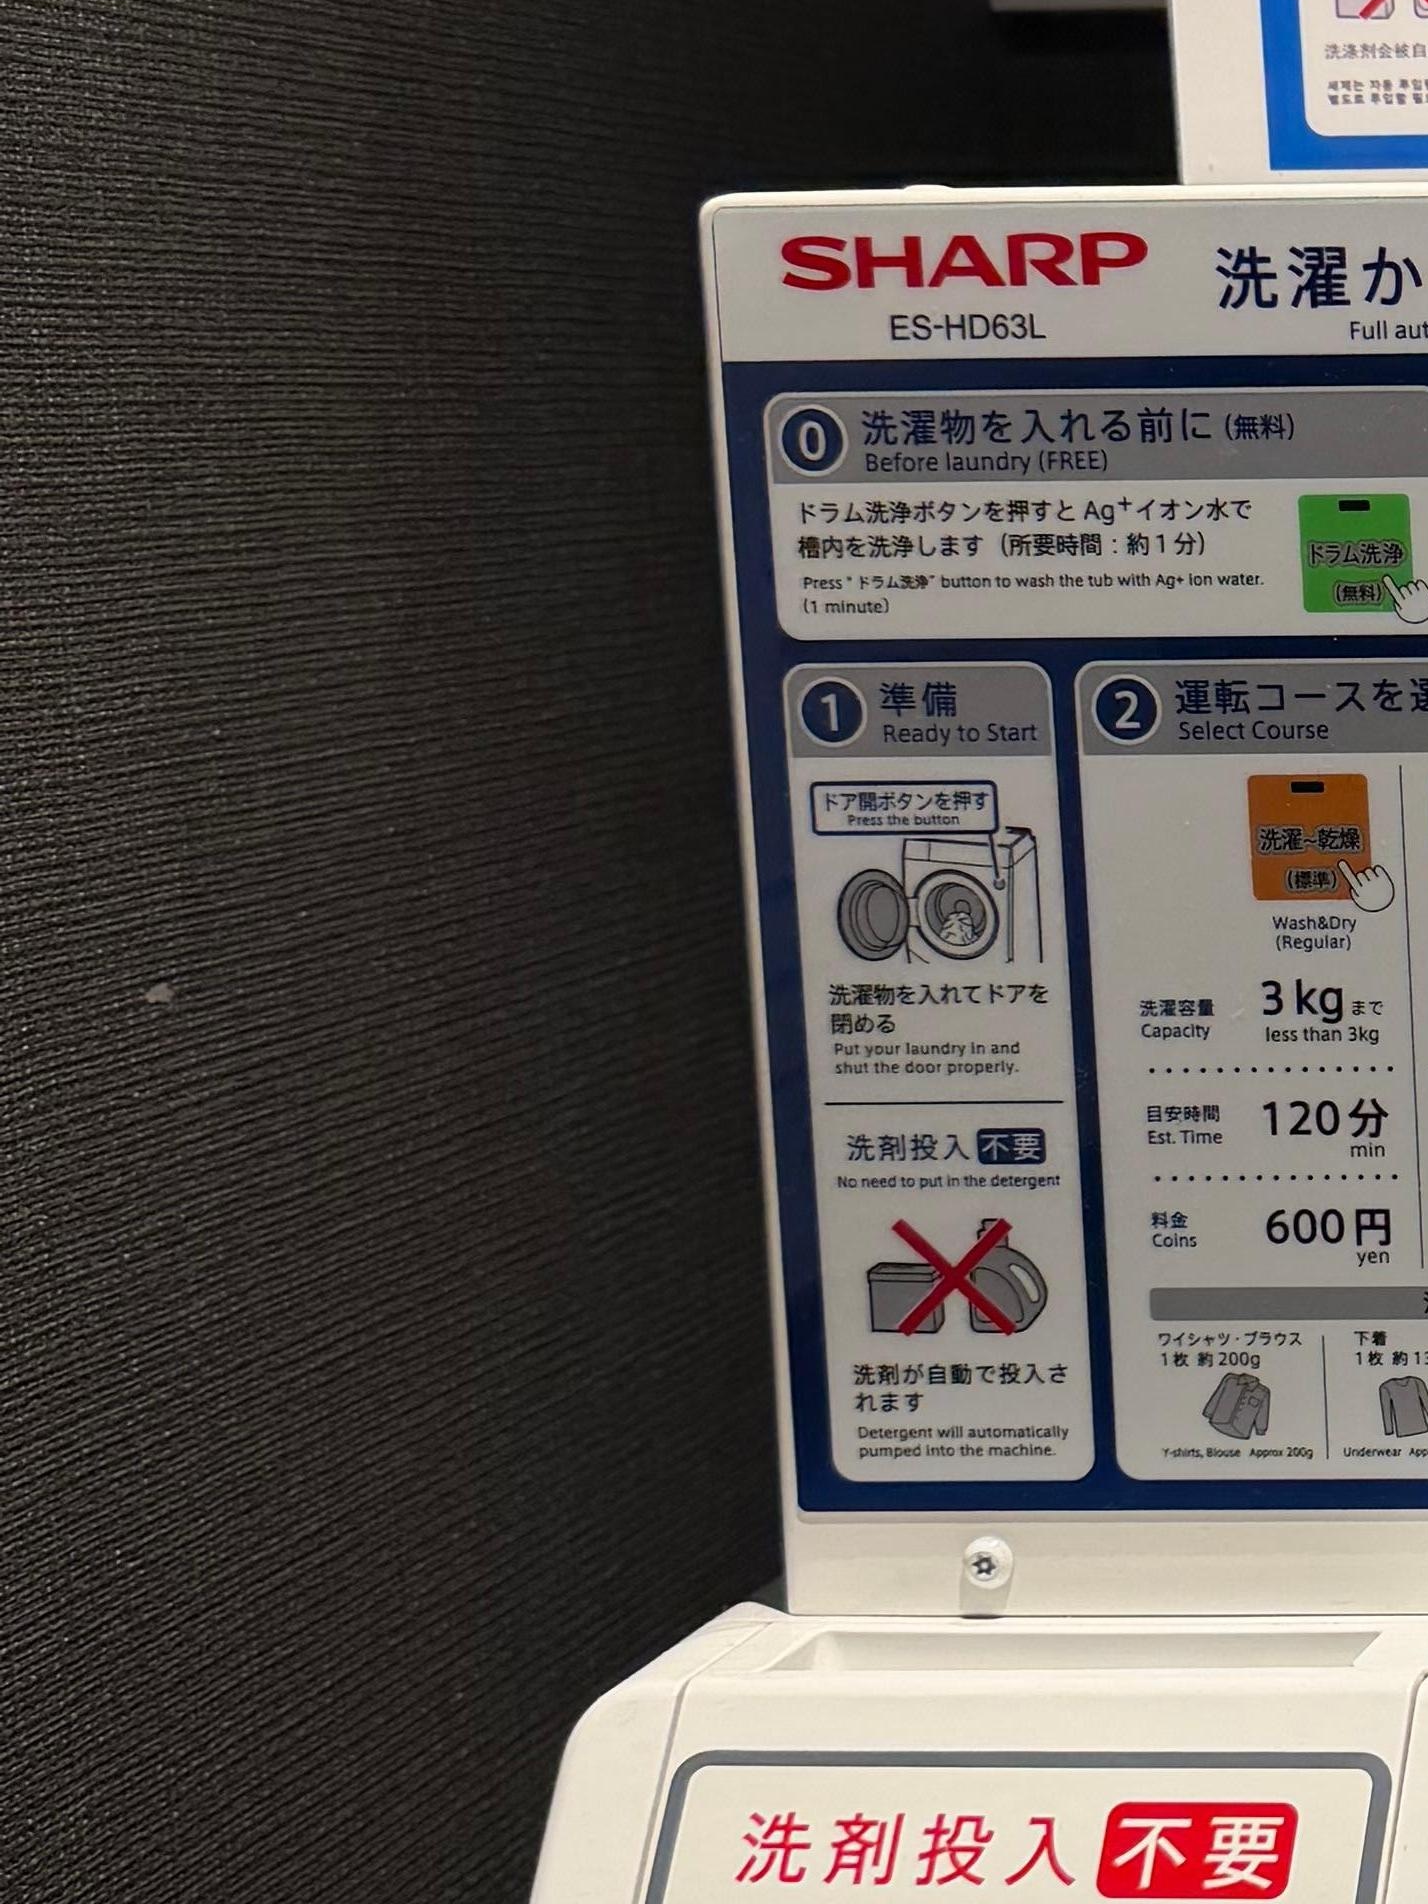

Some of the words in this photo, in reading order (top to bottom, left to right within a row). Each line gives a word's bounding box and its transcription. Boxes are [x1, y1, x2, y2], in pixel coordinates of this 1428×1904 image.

[780, 231, 1149, 291] SHARP
[889, 314, 1046, 342] ES-HD63L
[1349, 321, 1389, 341] Full
[861, 407, 1212, 446] 洗濯物を入れる前に
[864, 451, 938, 472] Before
[944, 451, 1031, 478] laundry
[1039, 450, 1108, 475] (FREE)
[879, 682, 957, 719] 準備
[882, 724, 951, 746] Ready
[956, 725, 981, 743] to
[987, 723, 1039, 742] Start
[1177, 721, 1245, 740] Select
[1252, 721, 1329, 740] Course
[1141, 1023, 1210, 1040] Capacity
[1147, 1130, 1176, 1145] Est.
[1179, 1129, 1224, 1145] Time
[733, 1812, 1076, 1888] 洗剤投入
[1110, 1815, 1286, 1891] 不要
